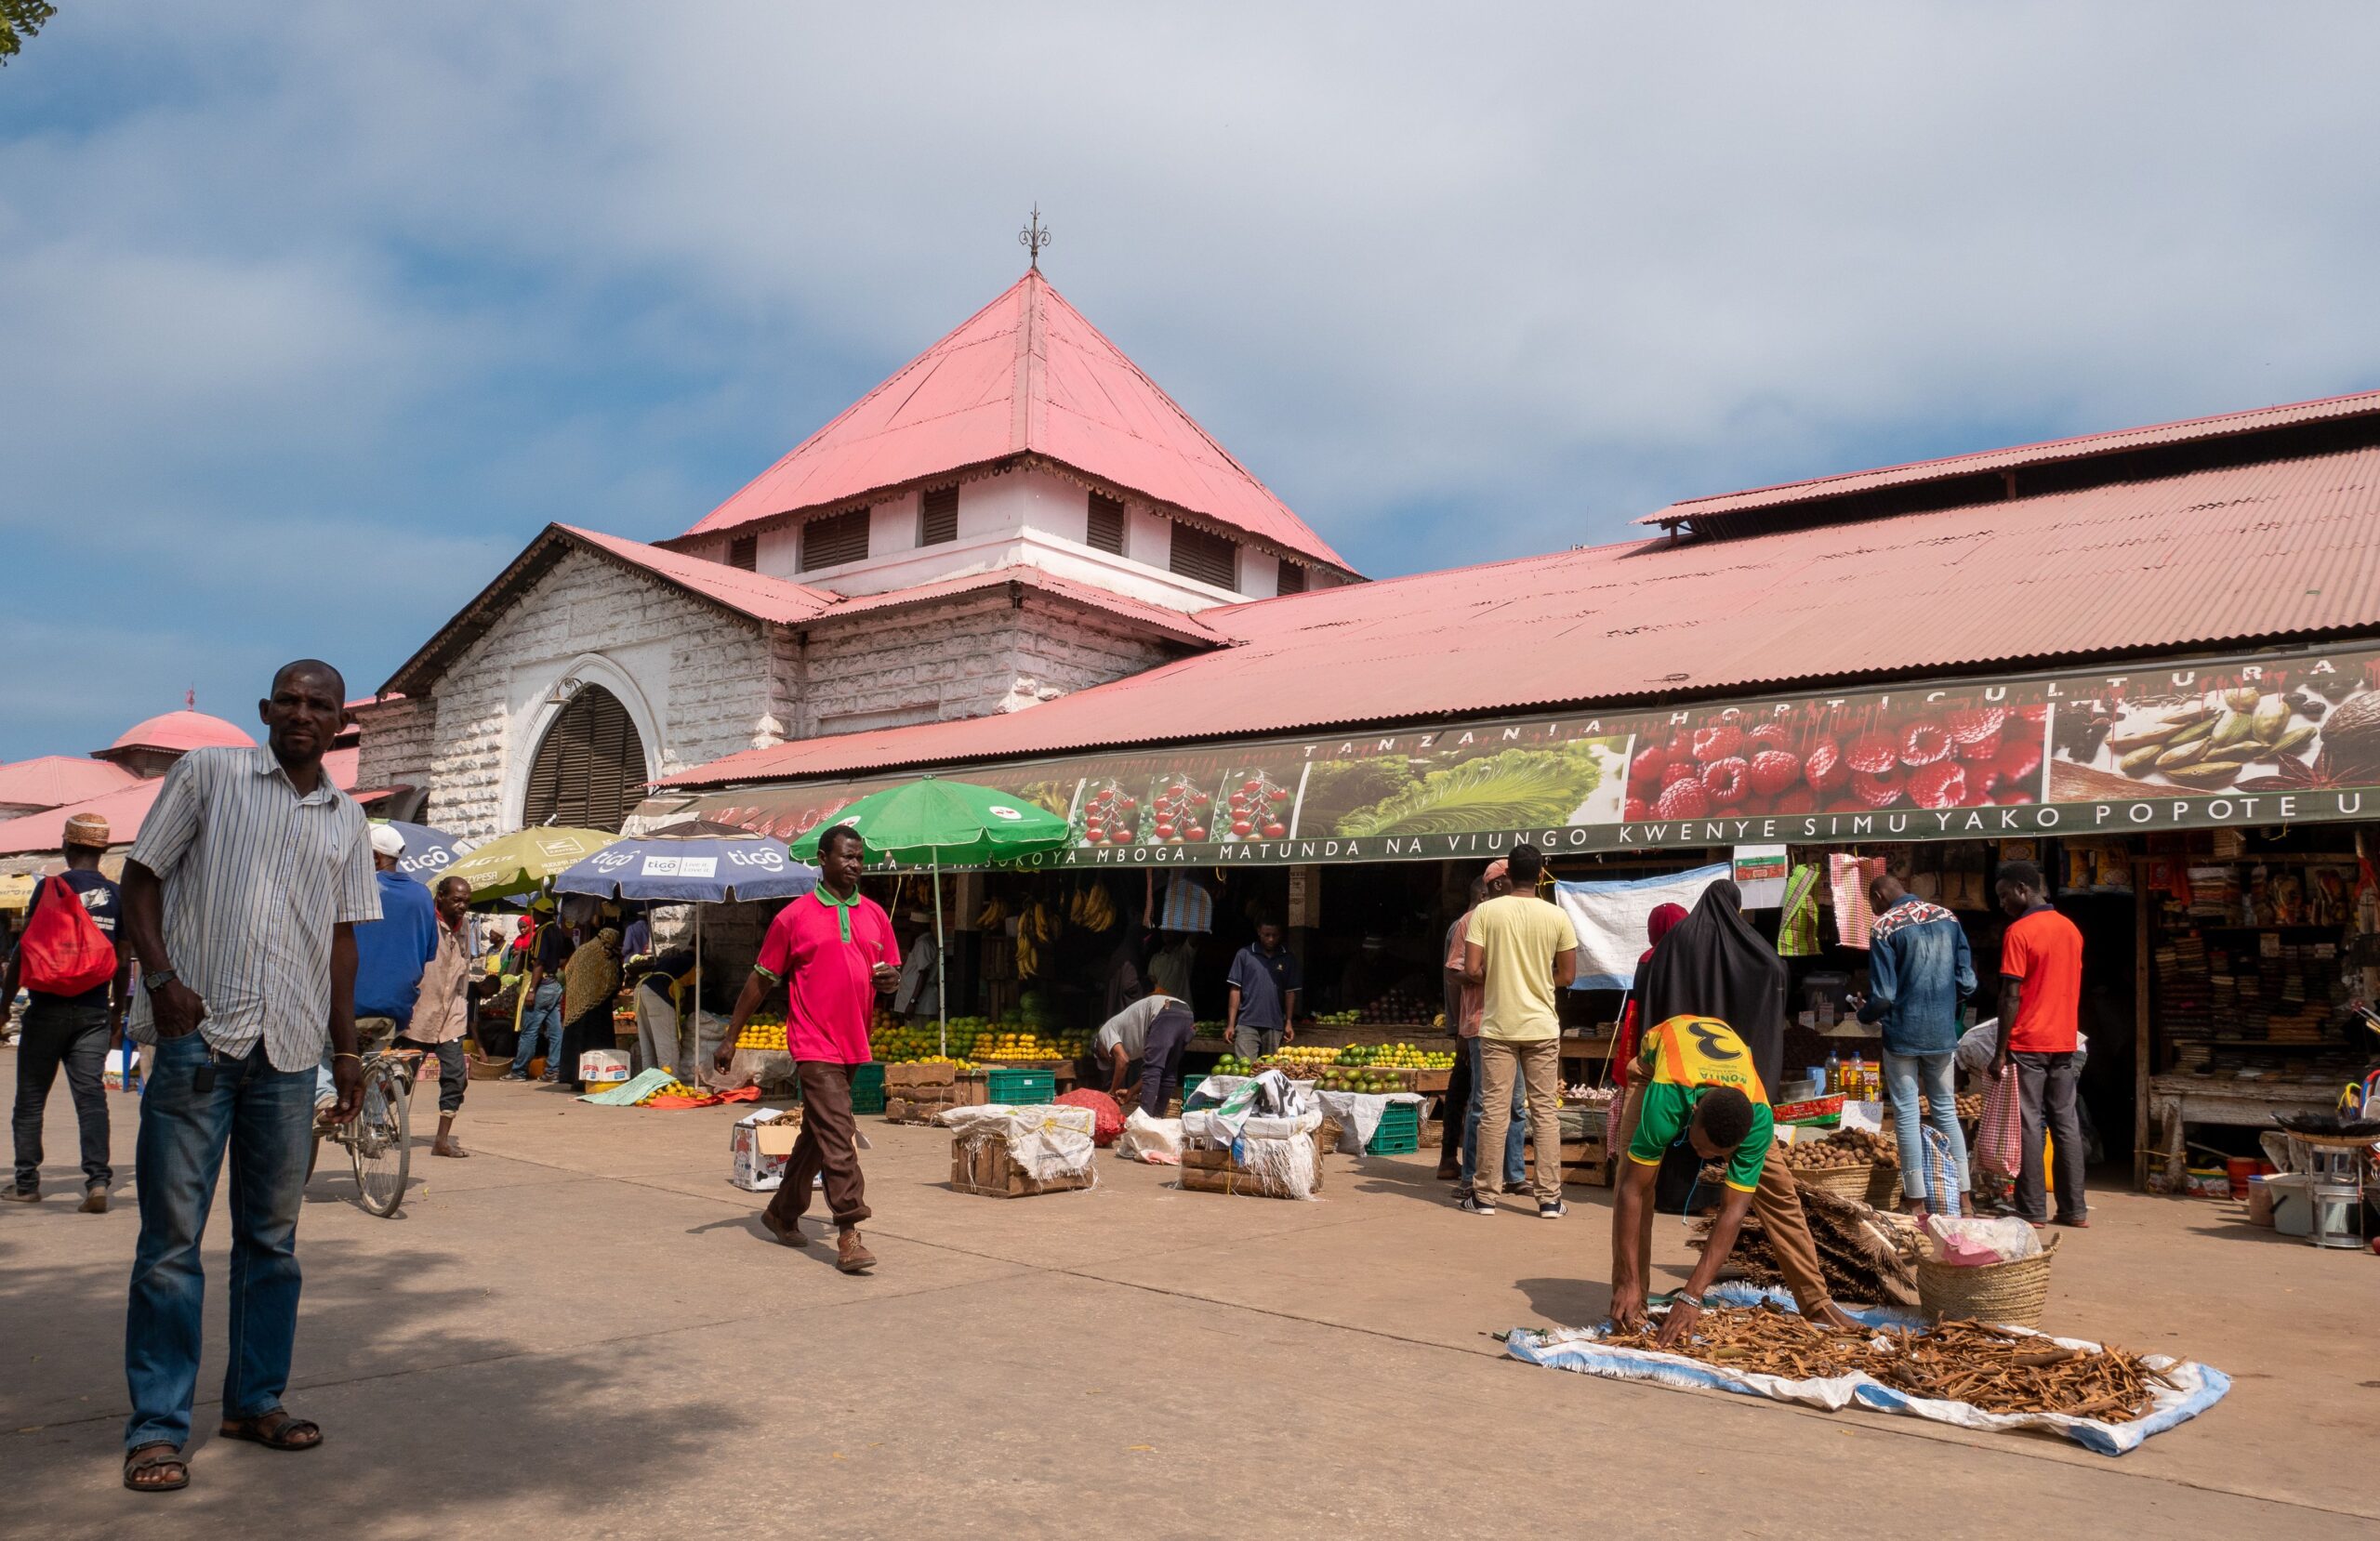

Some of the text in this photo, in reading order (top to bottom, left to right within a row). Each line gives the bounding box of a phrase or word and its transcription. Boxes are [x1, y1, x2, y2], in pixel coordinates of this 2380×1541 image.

[1303, 719, 1601, 757] TANZANIA
[1096, 847, 1197, 863] MBOGA,
[1219, 839, 1359, 860] MATUNDA
[1385, 837, 1422, 854] NA
[1448, 828, 1587, 850] VIUNGO
[1619, 820, 1776, 843] KWENYE
[1804, 814, 1907, 836] SIMU
[1936, 808, 2059, 831] YAKO
[2096, 797, 2296, 824] POPOTE
[2338, 792, 2360, 814] U
[1686, 1021, 1743, 1061] 3
